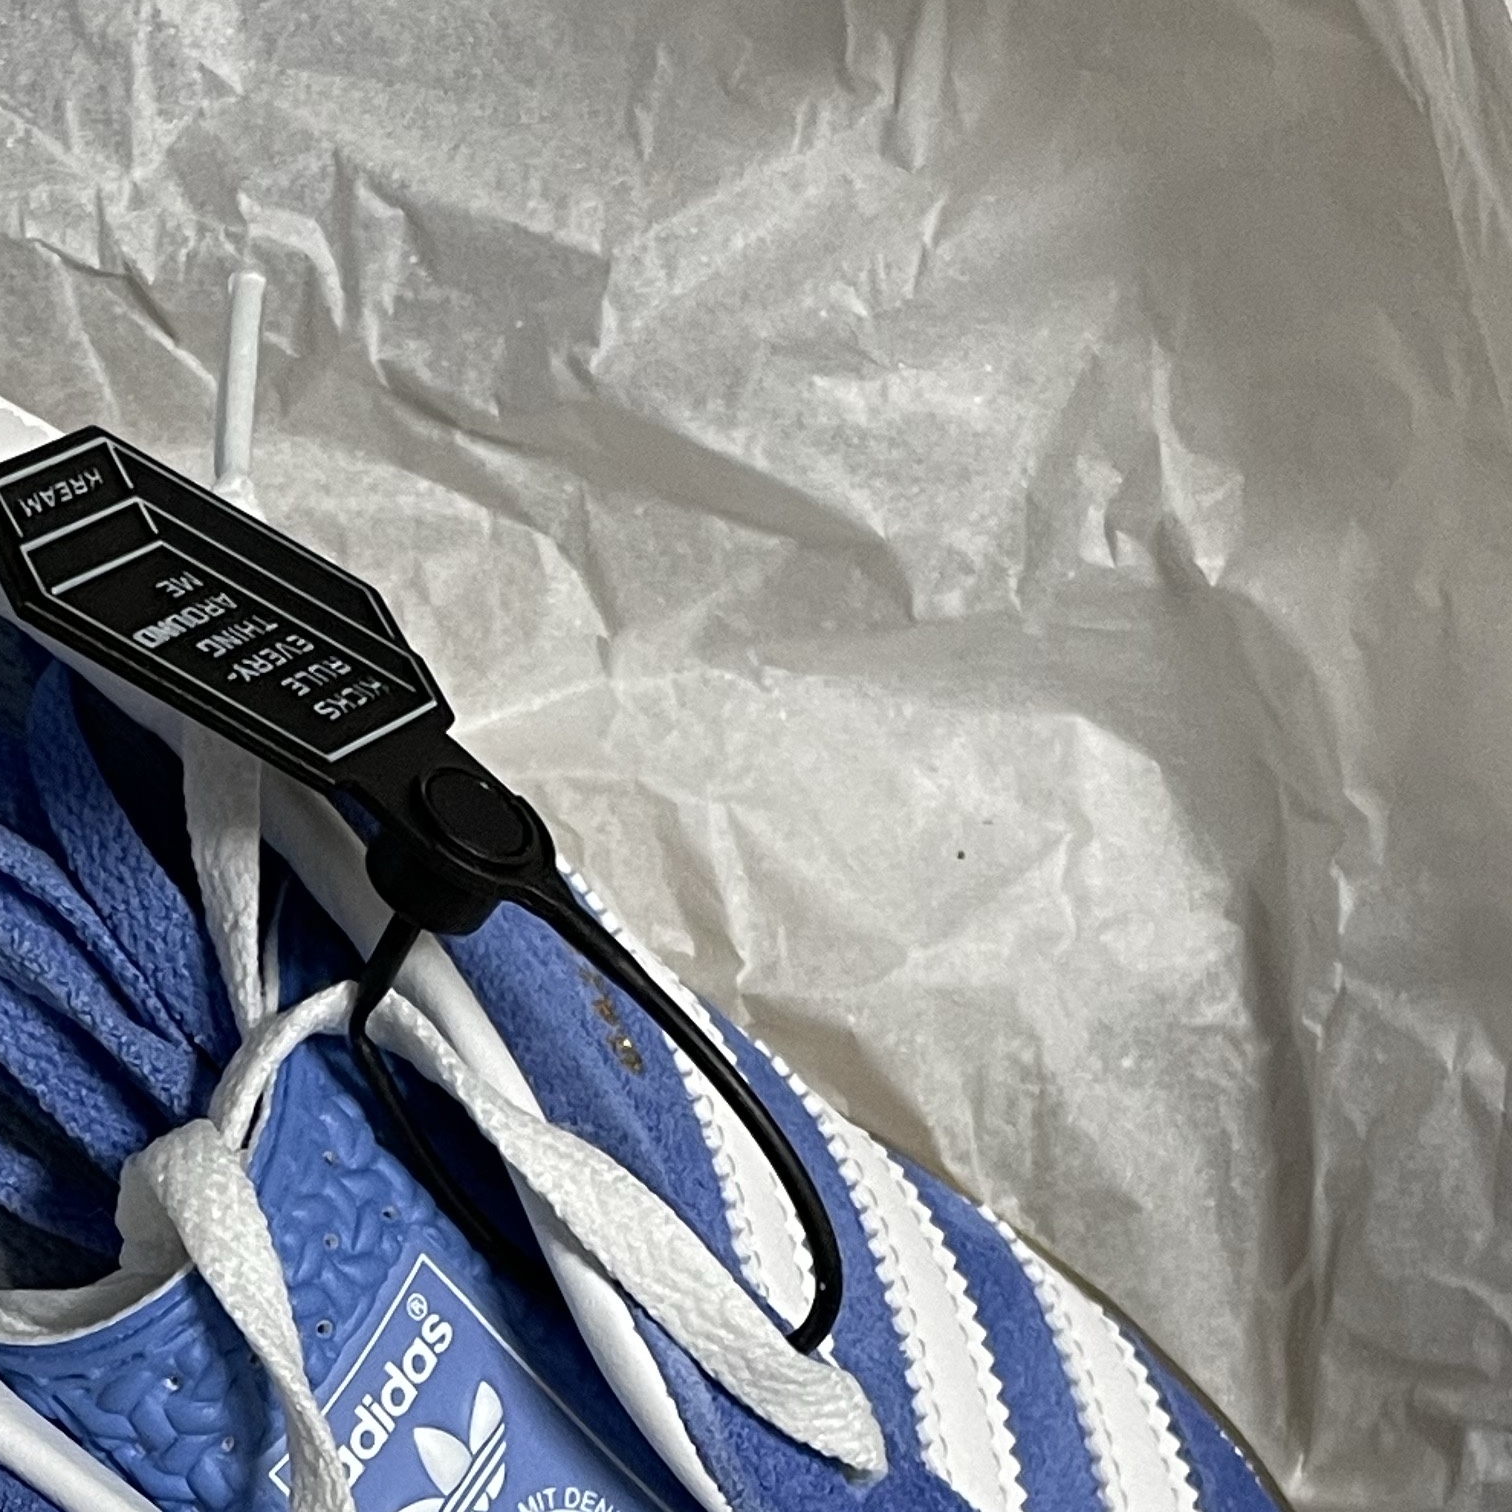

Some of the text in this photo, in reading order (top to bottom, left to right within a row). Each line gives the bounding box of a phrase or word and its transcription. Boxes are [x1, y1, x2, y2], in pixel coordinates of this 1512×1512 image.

[17, 467, 104, 518] KREAM
[155, 570, 204, 599] ME
[133, 592, 238, 649] AROUND
[195, 614, 279, 658] THING
[280, 656, 352, 697] RULE
[313, 677, 386, 721] KICKS
